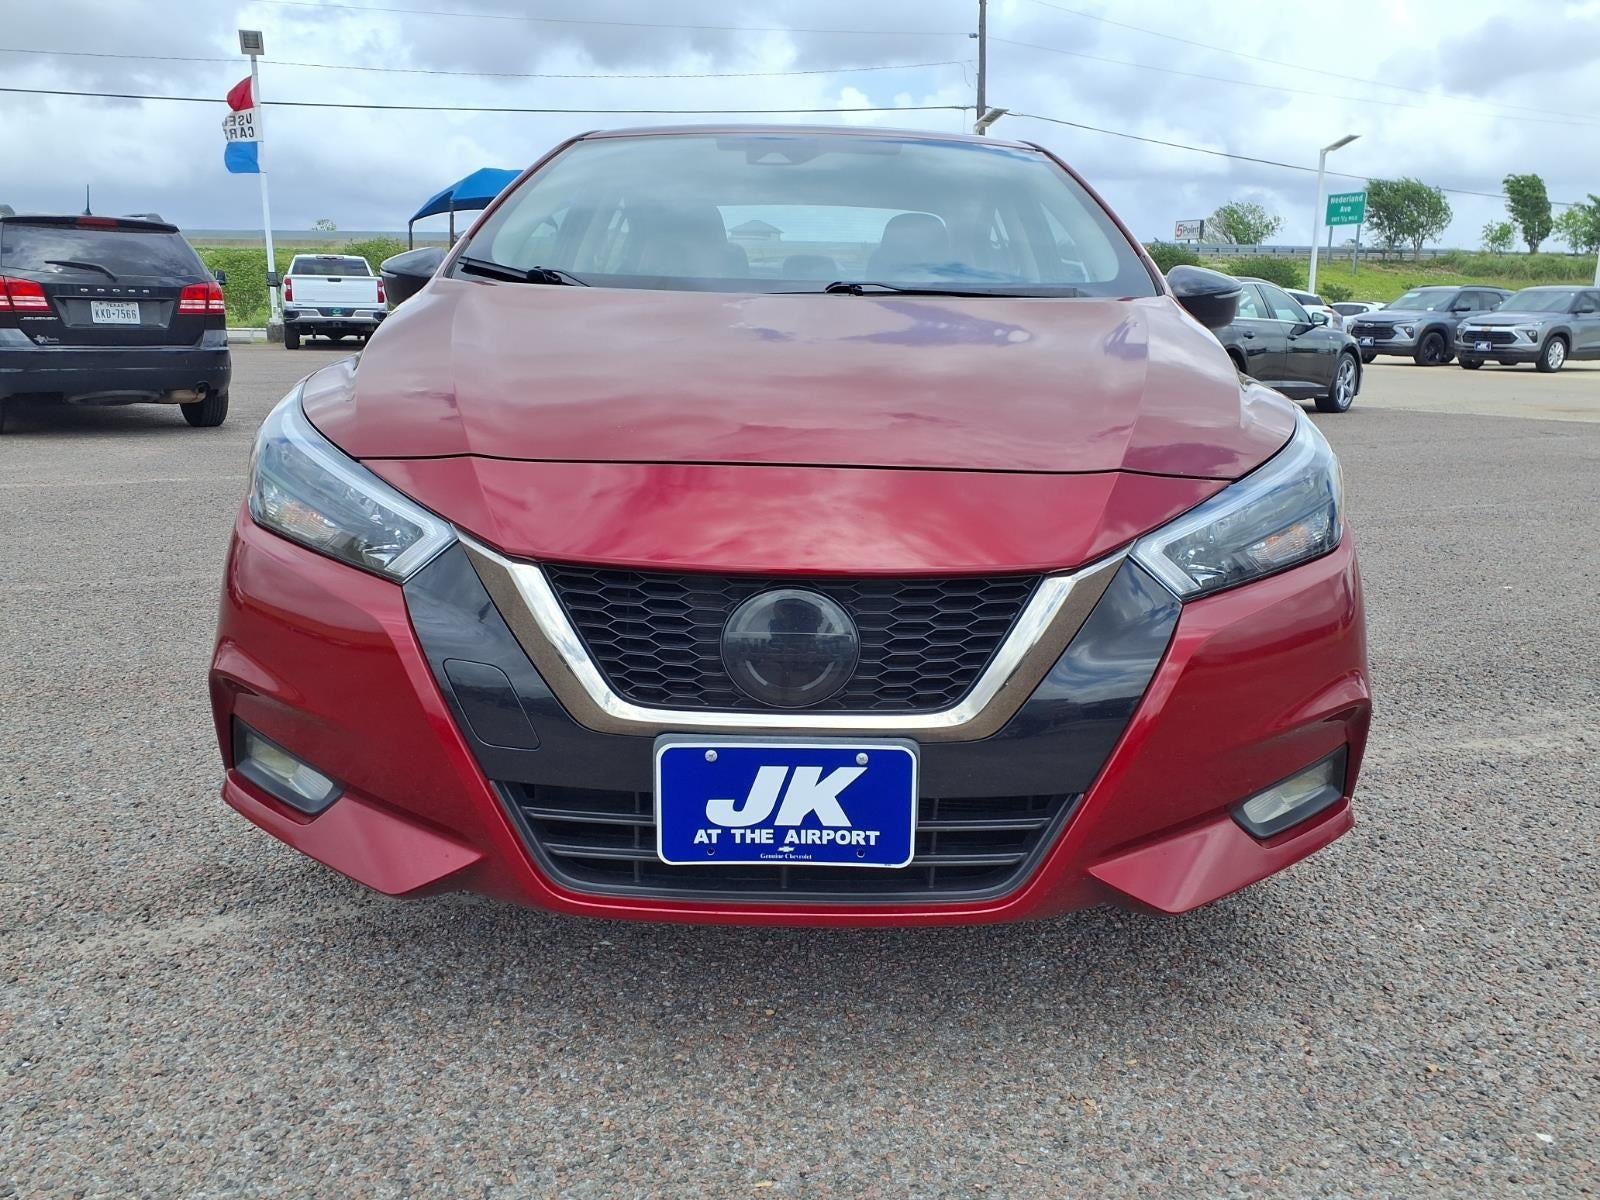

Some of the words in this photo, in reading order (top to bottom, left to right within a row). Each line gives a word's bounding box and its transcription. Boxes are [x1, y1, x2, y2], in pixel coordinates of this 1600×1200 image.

[1330, 194, 1364, 204] Nederland
[705, 765, 868, 827] JK
[693, 829, 722, 844] AT
[730, 829, 774, 844] THE
[783, 830, 880, 846] AIRPORT
[784, 853, 812, 861] Chevrolet
